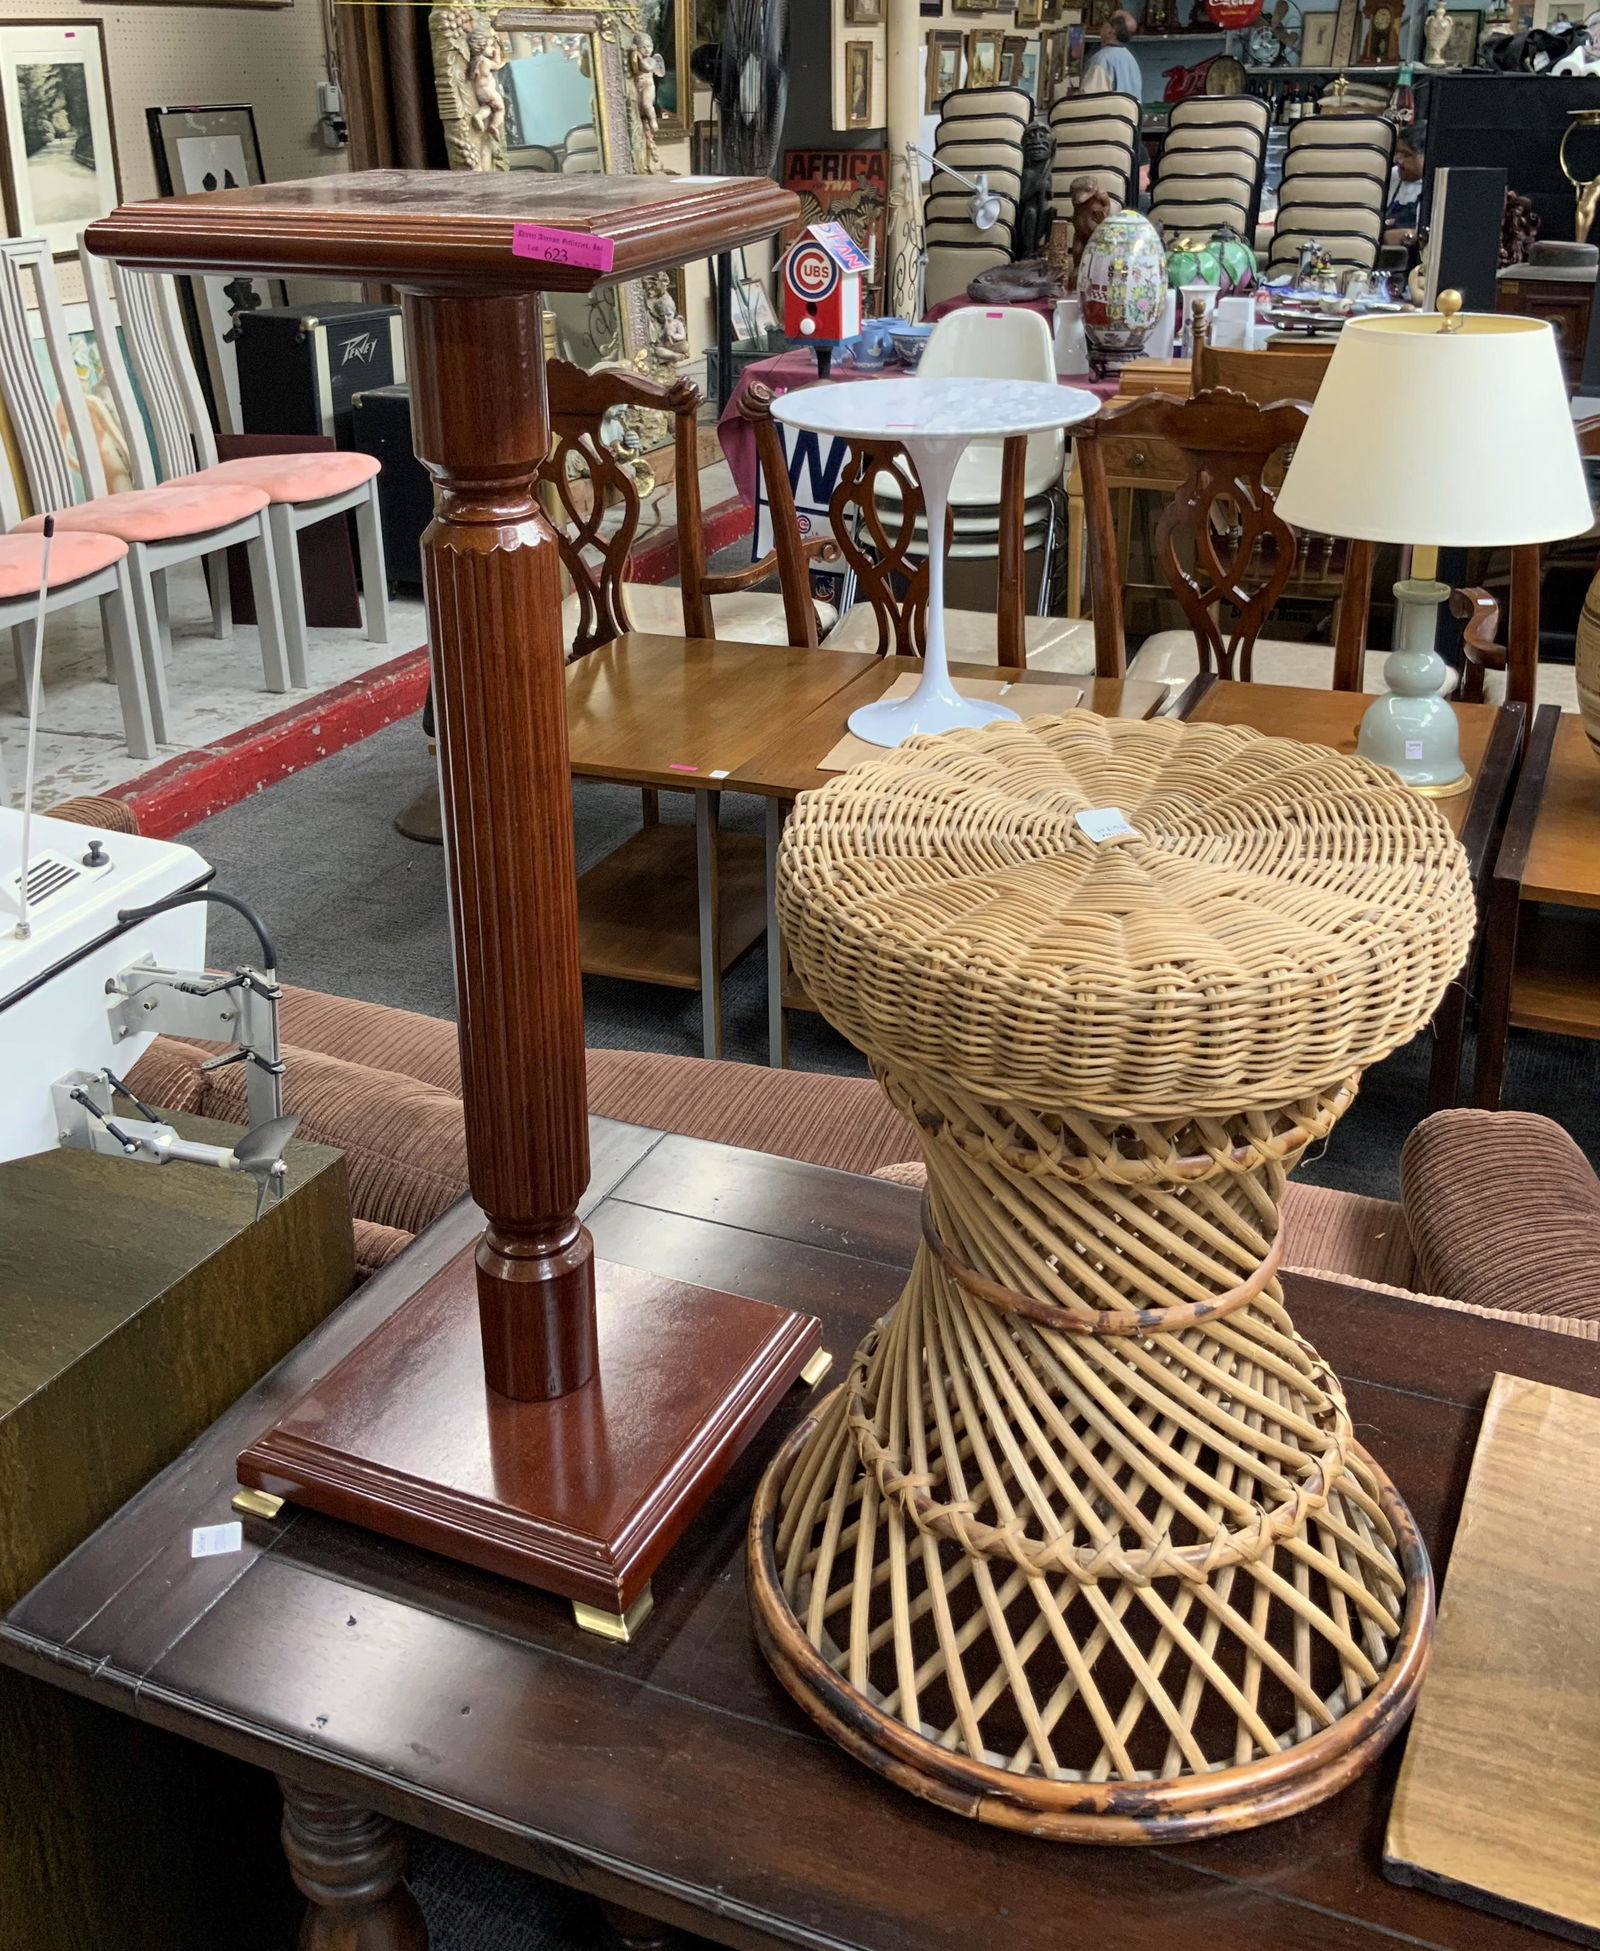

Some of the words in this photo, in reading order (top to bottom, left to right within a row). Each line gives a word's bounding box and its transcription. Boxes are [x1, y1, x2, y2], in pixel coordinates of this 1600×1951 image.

[788, 154, 885, 181] AFRICA
[824, 180, 853, 191] TWA
[544, 246, 569, 262] 623
[337, 332, 378, 367] PEAVEY
